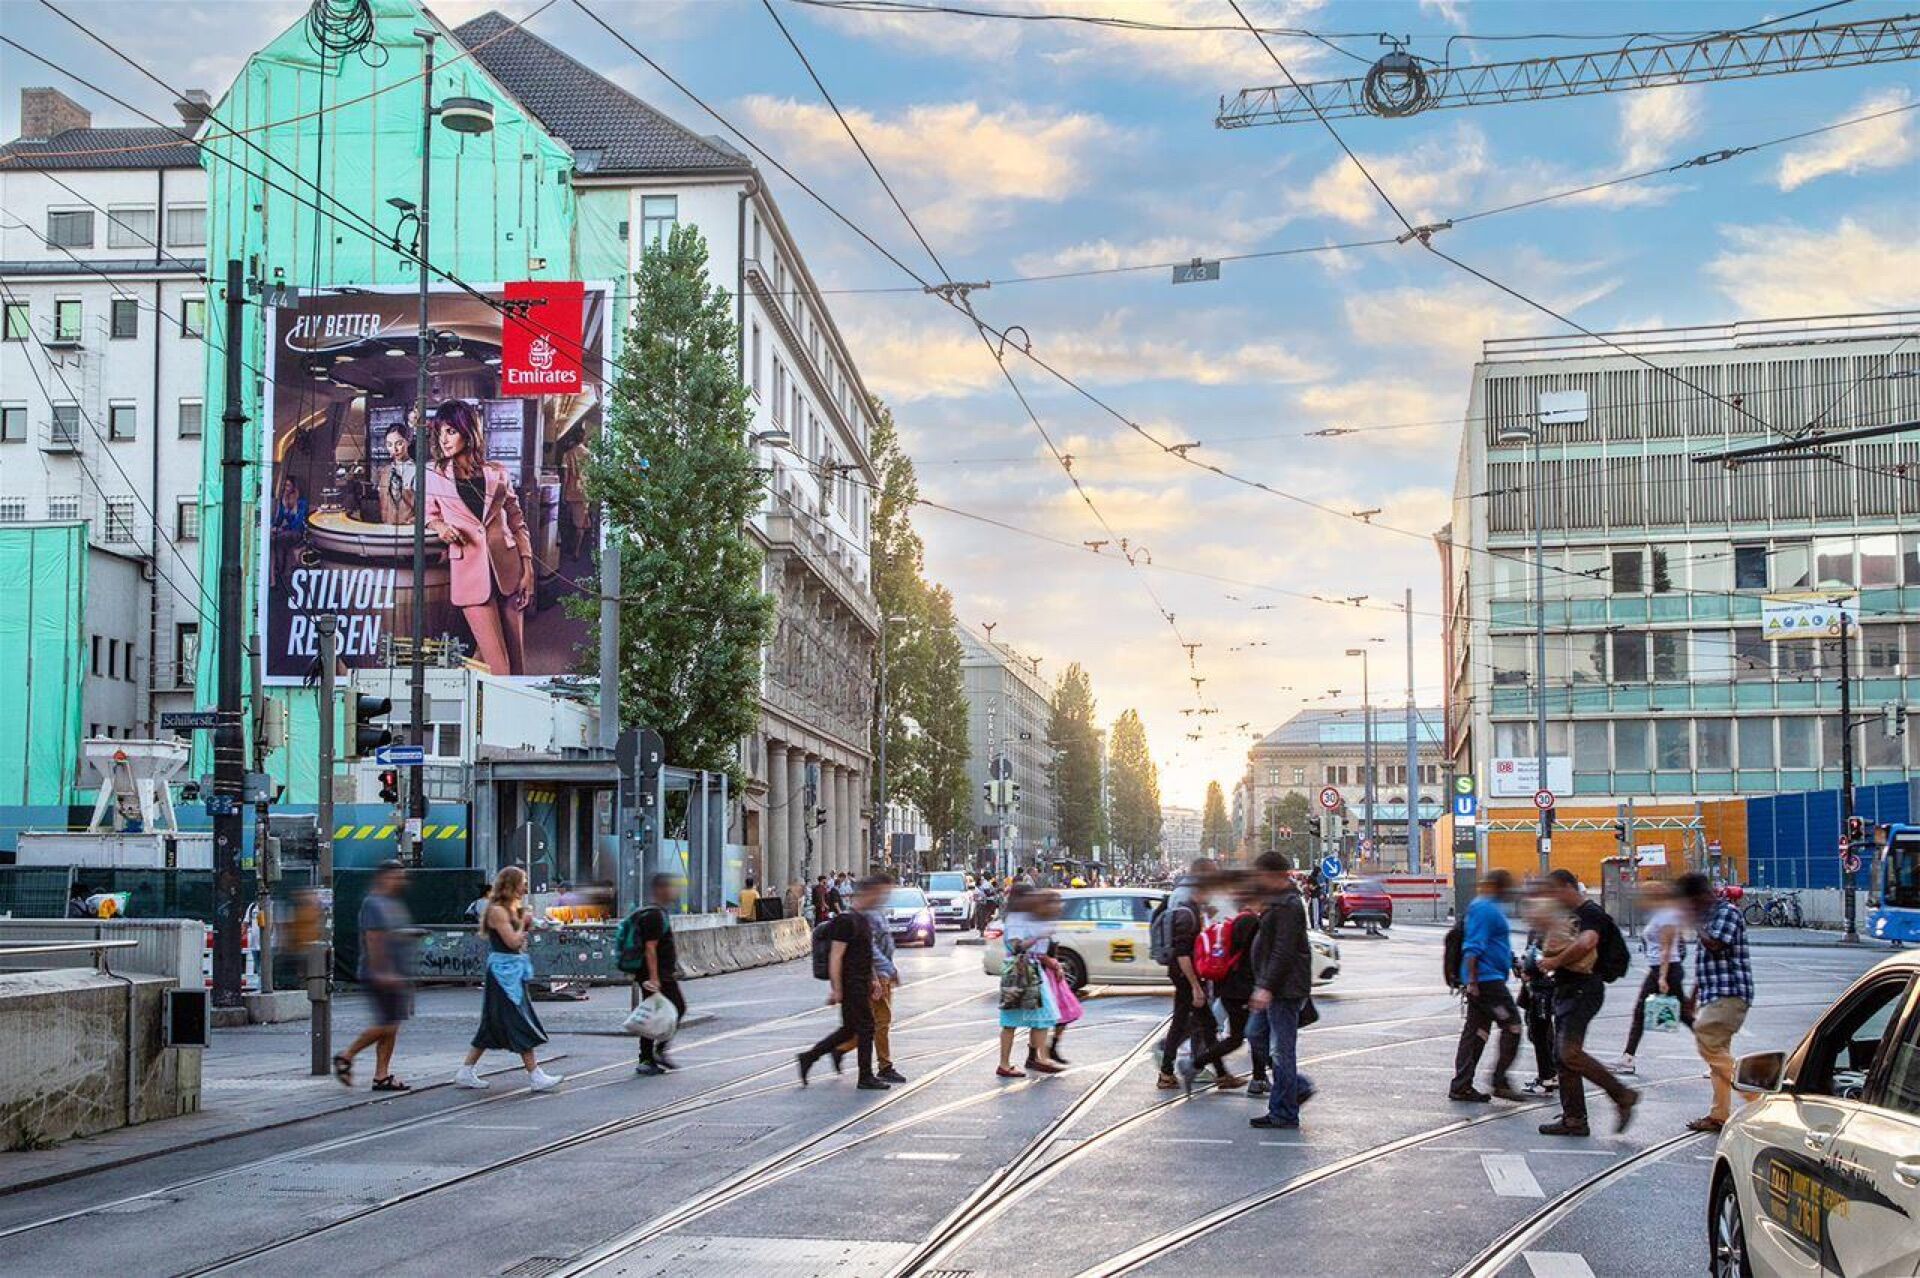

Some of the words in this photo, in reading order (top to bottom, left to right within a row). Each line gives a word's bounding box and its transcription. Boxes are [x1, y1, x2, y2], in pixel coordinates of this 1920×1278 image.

[1184, 266, 1207, 280] 43
[269, 292, 288, 308] 44
[325, 314, 381, 337] BETTER
[507, 367, 577, 385] Emirates
[287, 568, 396, 610] STILVOLL
[287, 614, 382, 656] RESEN
[1458, 777, 1472, 793] S
[1324, 792, 1336, 803] 30
[1538, 794, 1551, 805] 30
[1458, 798, 1471, 814] U
